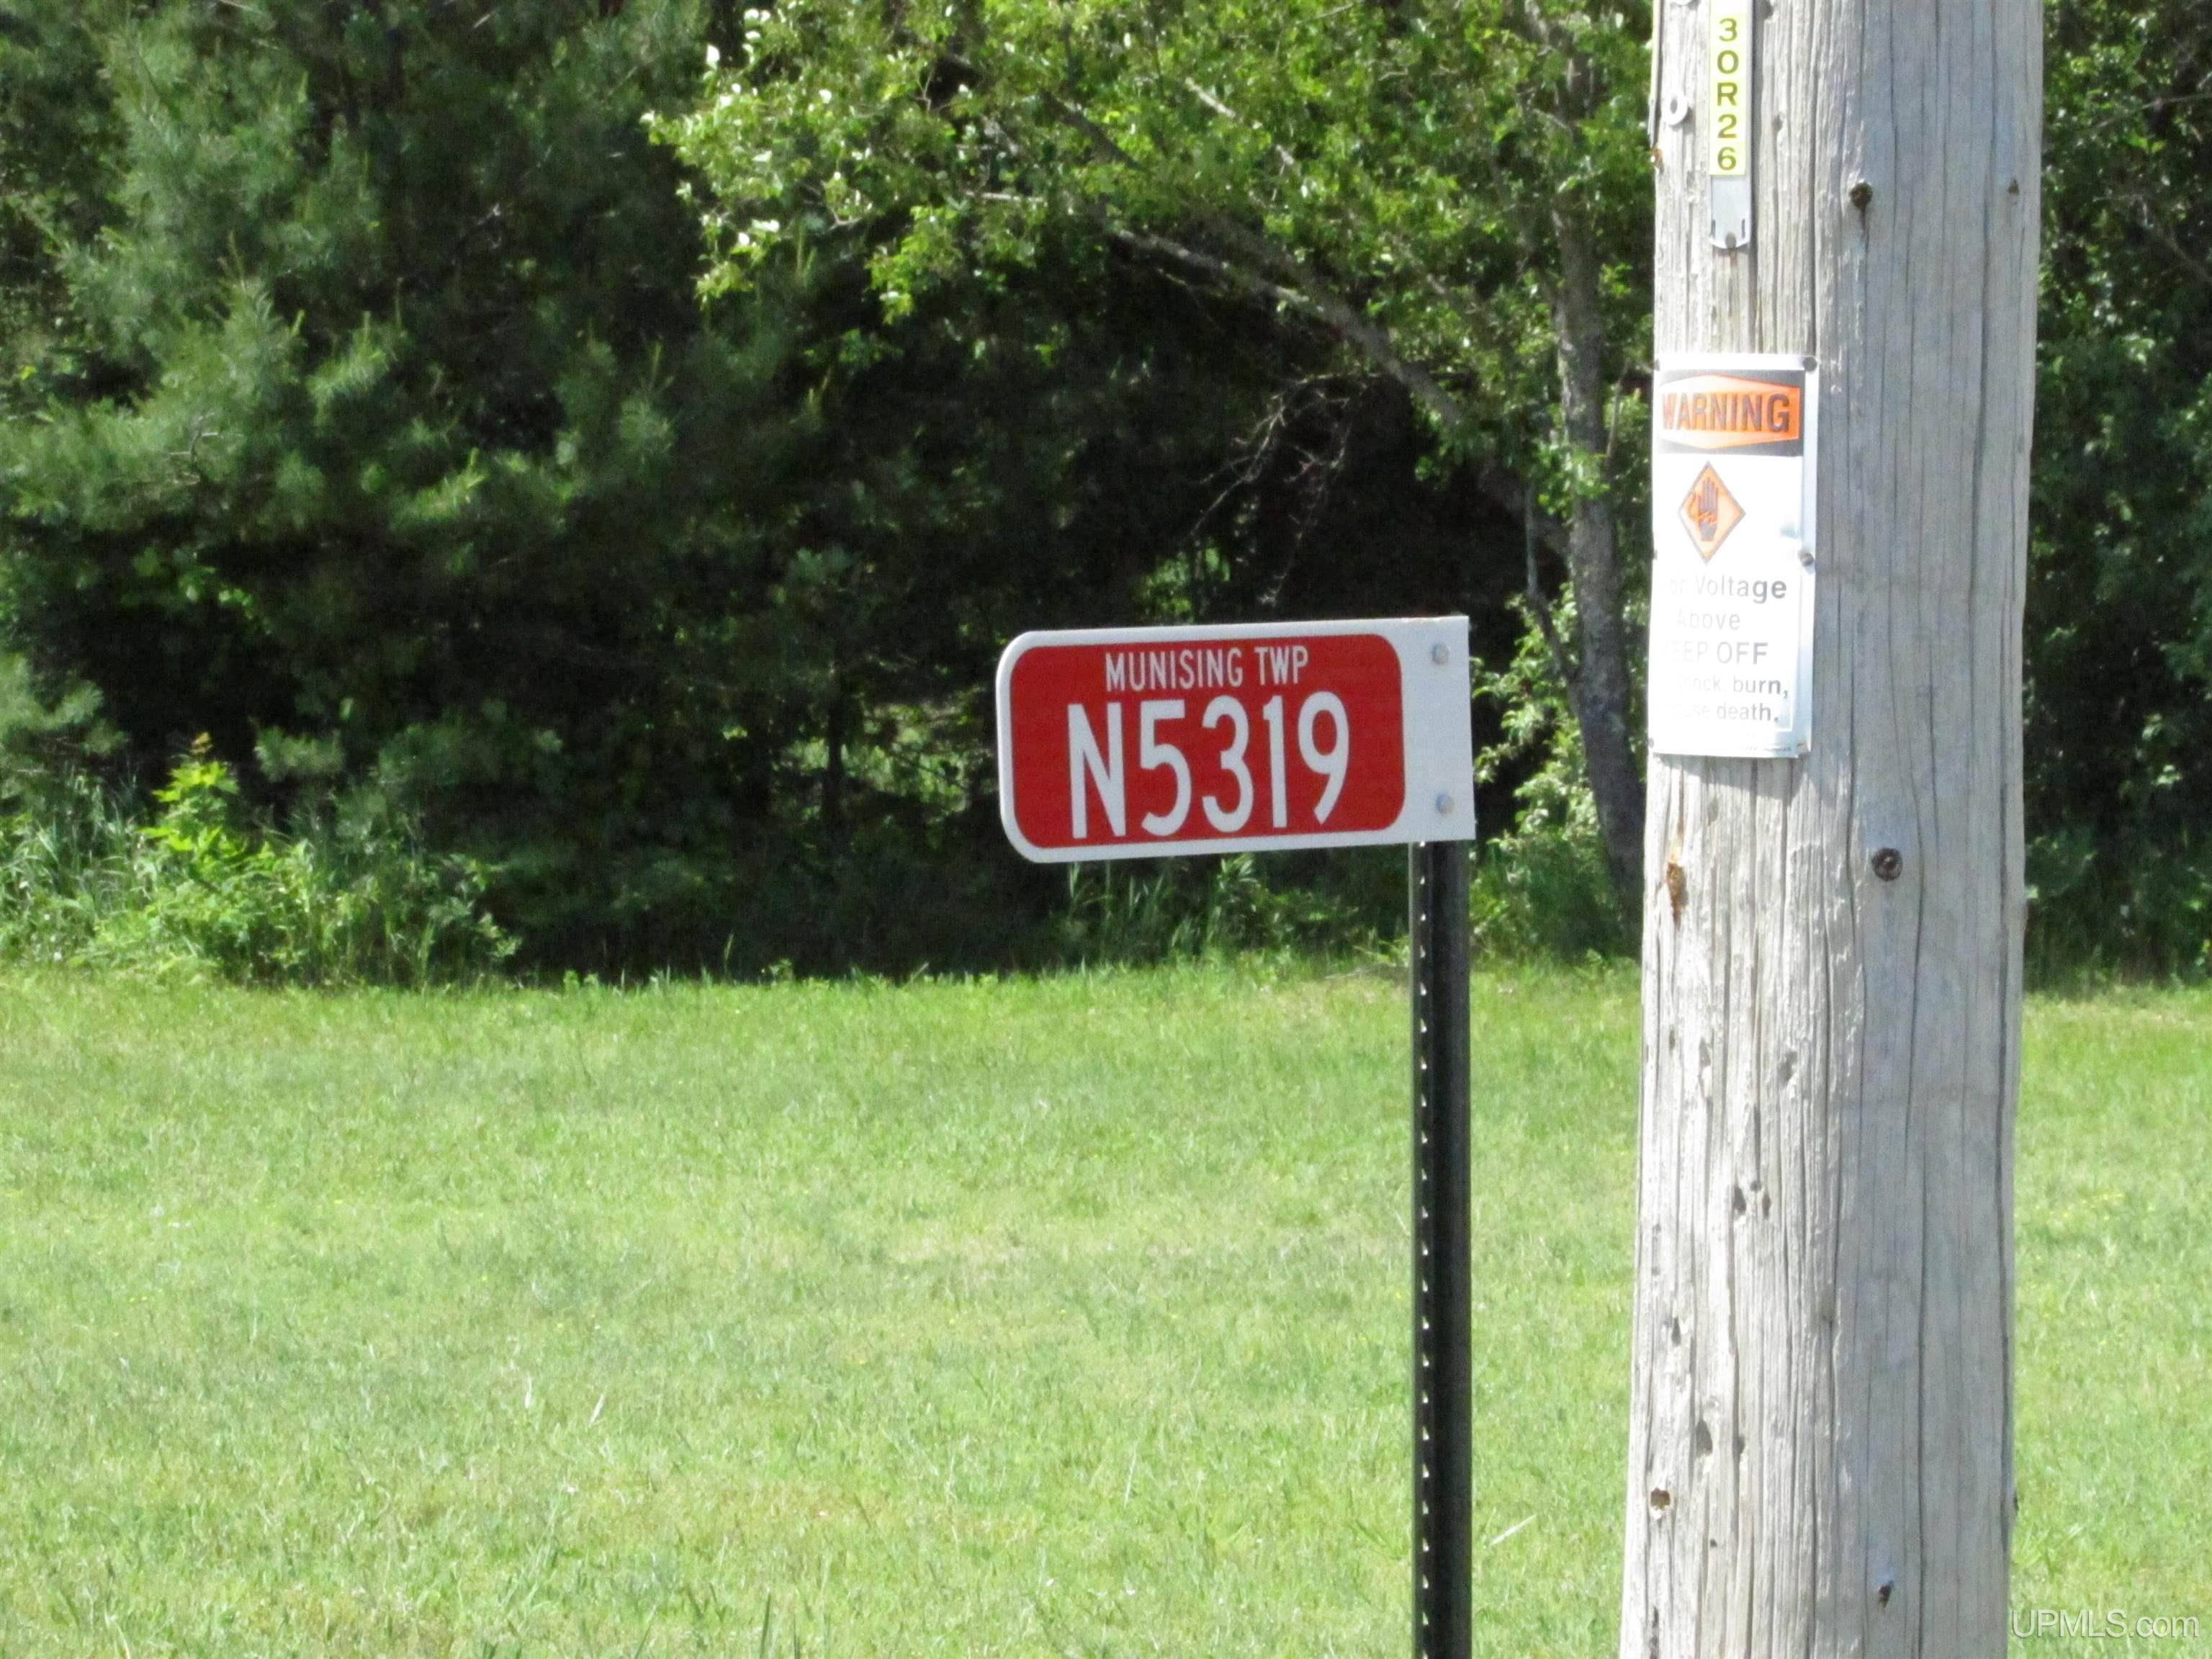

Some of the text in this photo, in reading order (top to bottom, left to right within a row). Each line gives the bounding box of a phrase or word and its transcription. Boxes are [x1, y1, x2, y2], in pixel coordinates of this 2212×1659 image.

[1662, 393, 1790, 433] WARNING
[1694, 574, 1787, 604] Voltage
[1105, 645, 1308, 692] MUNISING TWP
[1717, 641, 1769, 665] OFF
[1733, 675, 1788, 698] burn,
[1067, 691, 1350, 839] N5319
